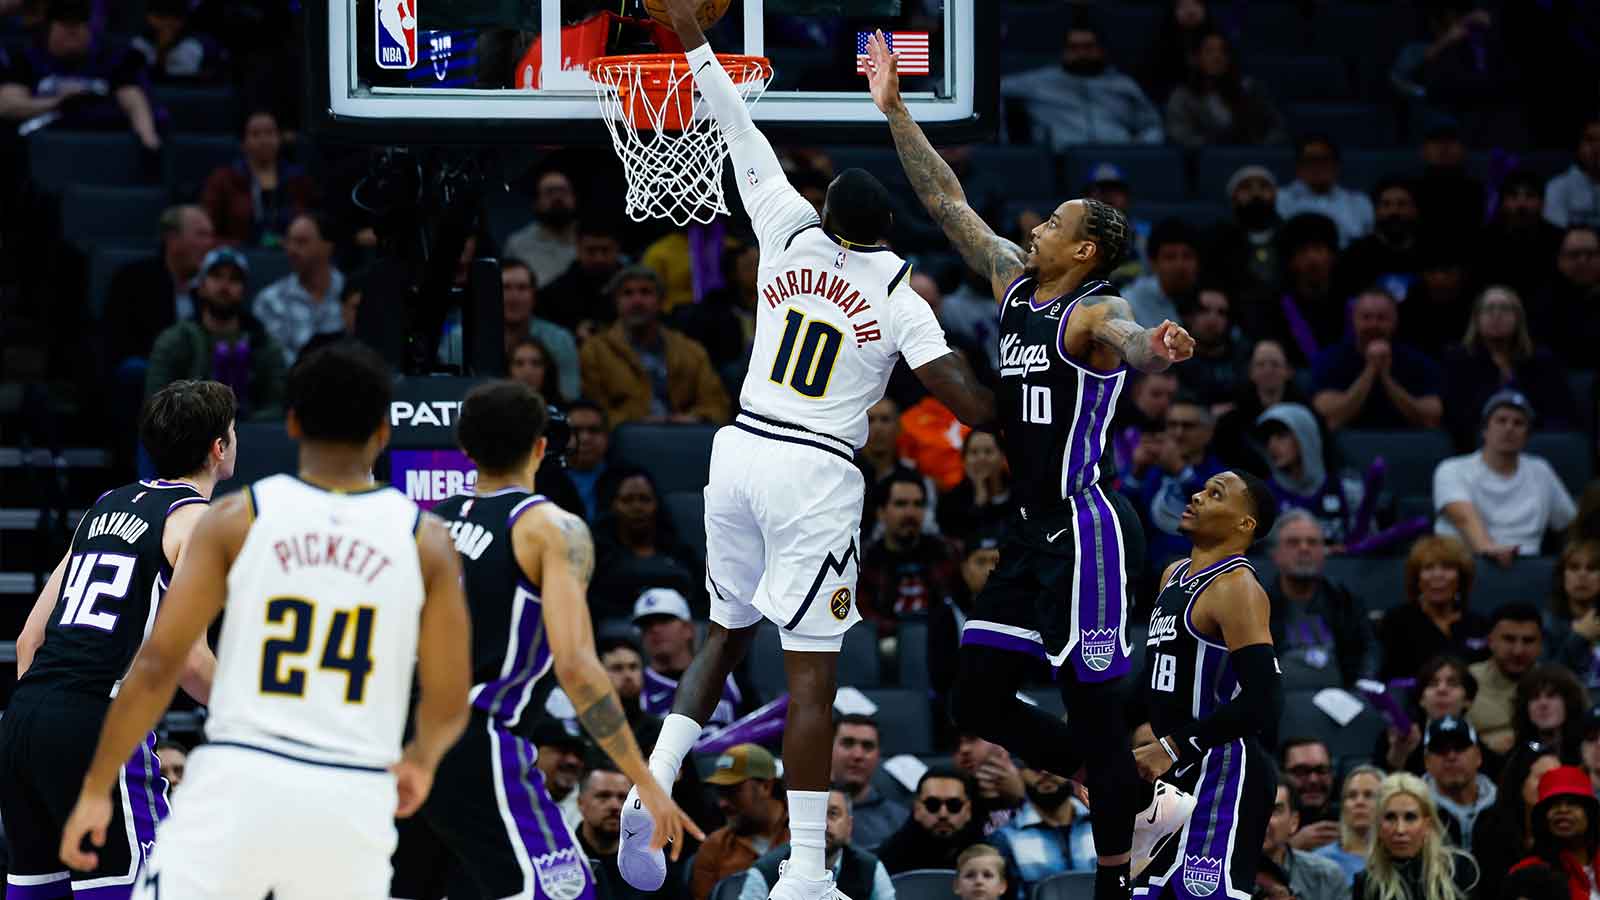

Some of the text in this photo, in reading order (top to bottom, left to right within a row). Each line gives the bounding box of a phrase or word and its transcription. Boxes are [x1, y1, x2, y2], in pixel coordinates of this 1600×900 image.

[382, 47, 402, 63] NBA
[763, 268, 881, 348] HARDAWAY JR.
[768, 306, 844, 398] 10
[1000, 332, 1050, 378] Kings
[391, 401, 464, 426] PAT
[1022, 383, 1052, 424] 10
[87, 511, 149, 545] RAYNAUD
[274, 531, 392, 583] PICKETT
[59, 552, 138, 632] 42
[259, 594, 377, 705] 24
[1151, 652, 1177, 693] 18
[1184, 870, 1218, 883] KINGS
